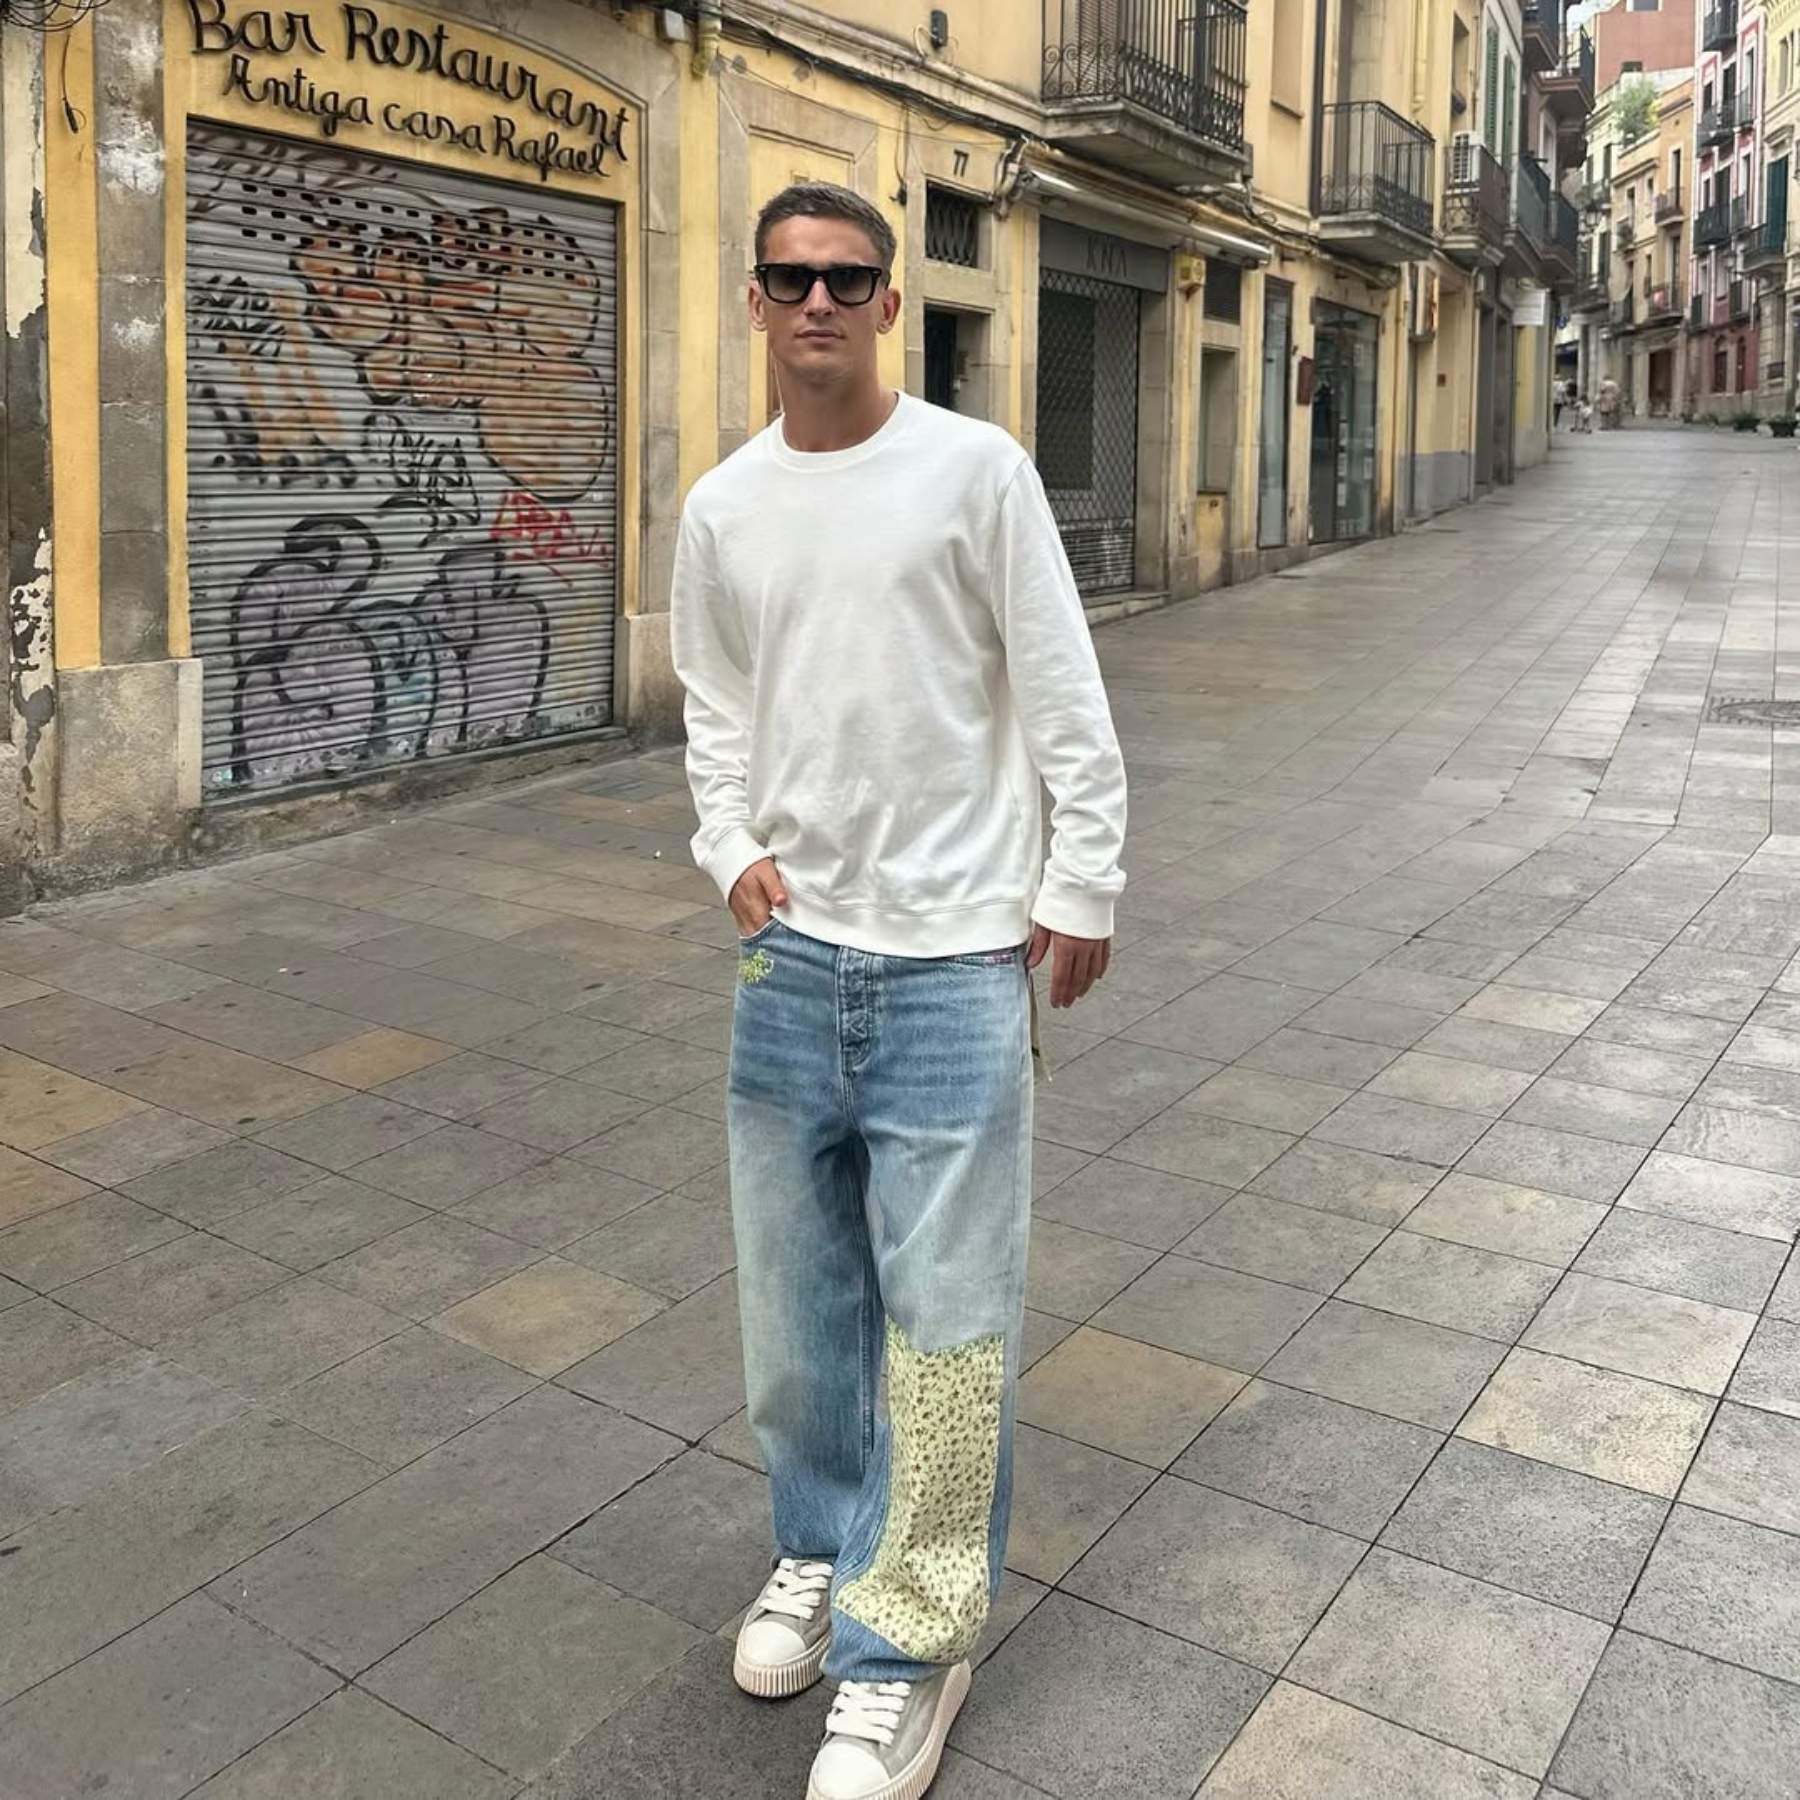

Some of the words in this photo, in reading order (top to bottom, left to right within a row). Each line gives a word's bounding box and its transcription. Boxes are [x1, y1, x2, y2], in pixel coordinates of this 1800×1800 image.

[188, 0, 325, 54] Bar
[343, 3, 629, 161] Restaurant
[222, 53, 374, 136] Antiga
[383, 103, 487, 155] casa
[493, 114, 610, 182] Rafael
[953, 149, 970, 177] 77
